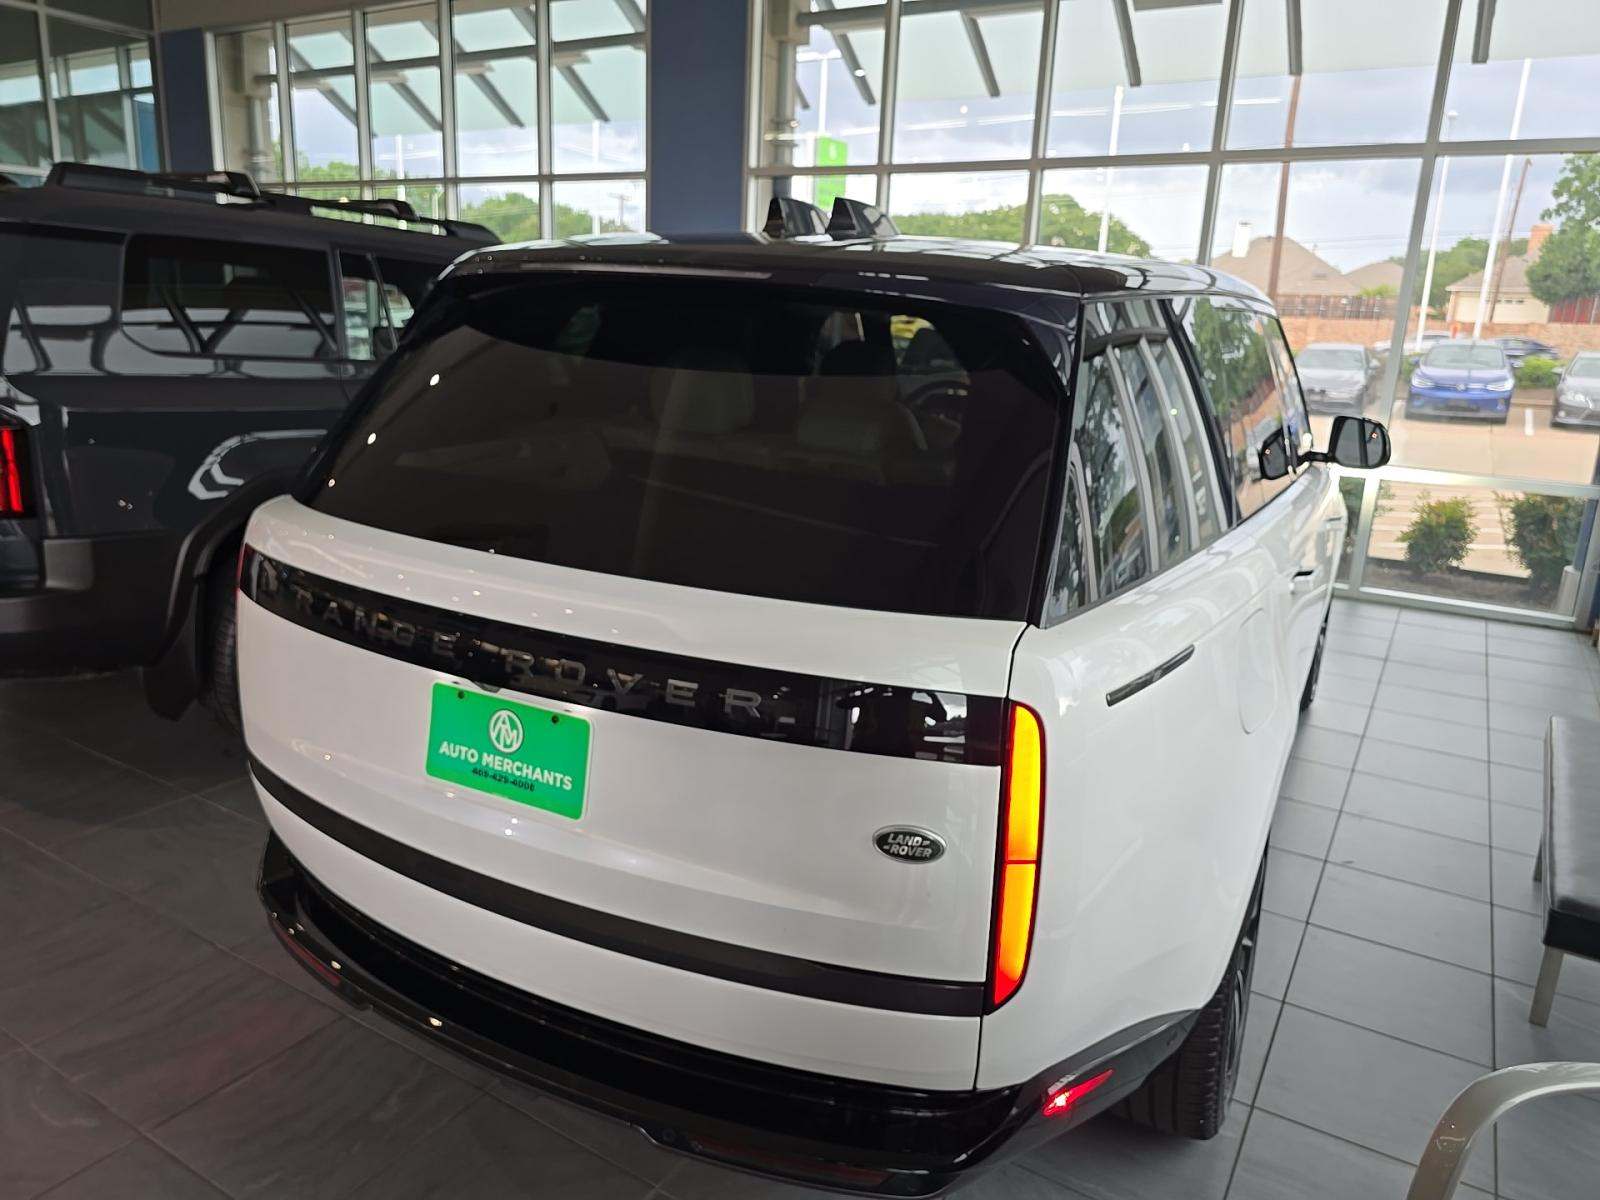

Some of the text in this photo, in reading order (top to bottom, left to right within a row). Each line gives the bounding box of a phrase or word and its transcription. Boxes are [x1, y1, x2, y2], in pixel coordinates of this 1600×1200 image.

[504, 648, 762, 719] ROVER
[439, 741, 573, 791] AUTO MERCHANTS
[887, 833, 923, 847] LAND
[889, 844, 933, 858] ROVER
